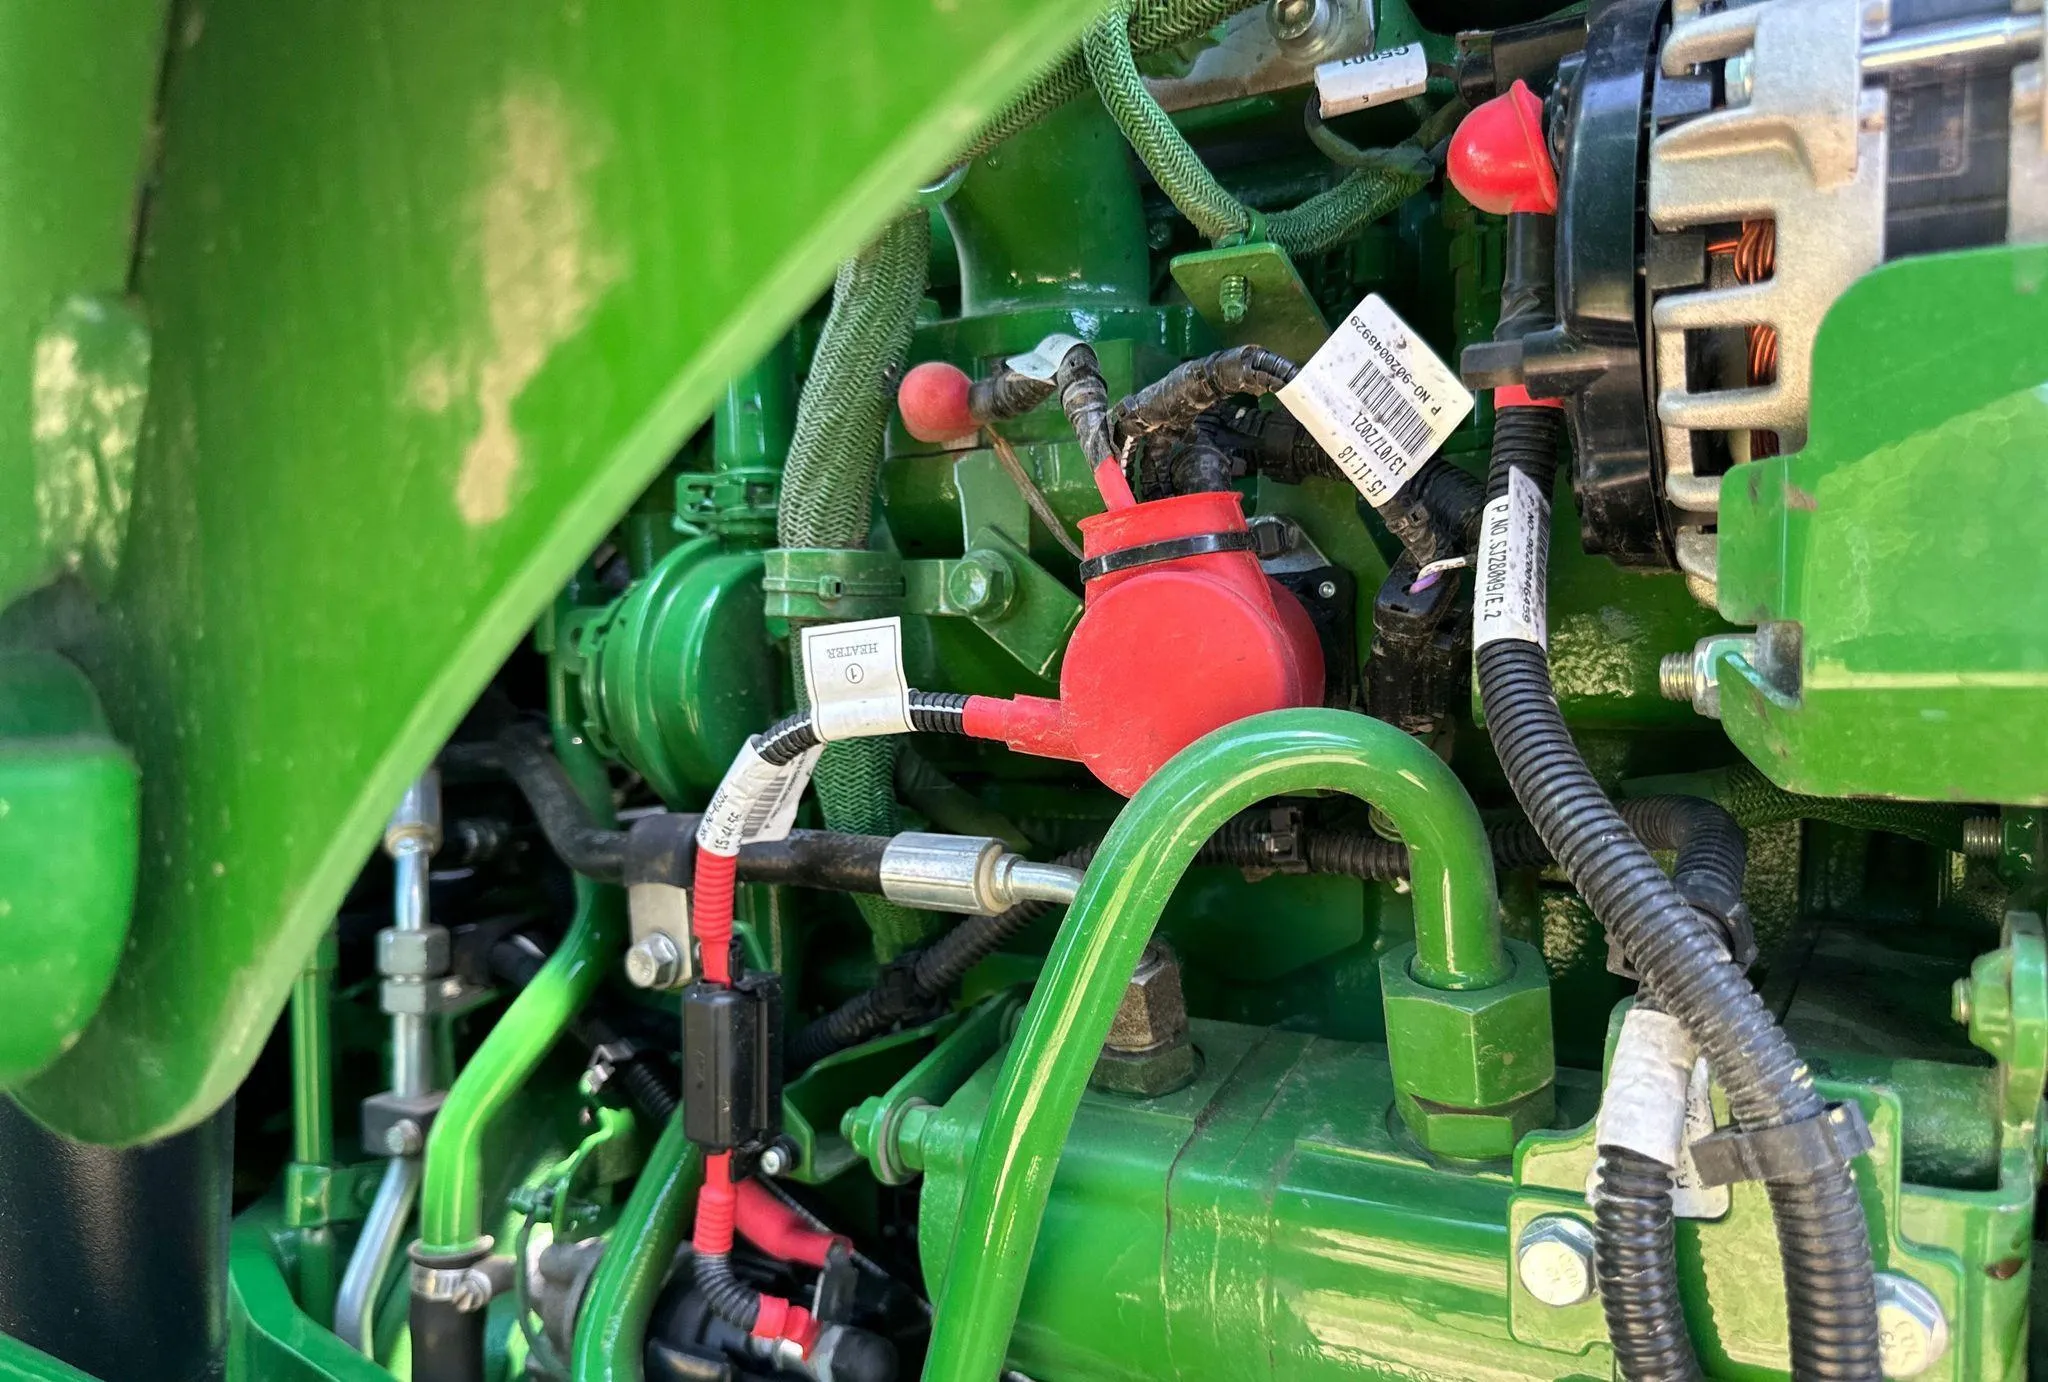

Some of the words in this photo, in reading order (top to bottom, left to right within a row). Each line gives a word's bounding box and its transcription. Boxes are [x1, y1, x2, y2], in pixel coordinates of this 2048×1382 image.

[1350, 315, 1442, 416] P.NO-9020048929
[1337, 445, 1387, 497] 15:11:18
[1349, 411, 1407, 477] 13/07/2021
[826, 643, 878, 659] HEATER
